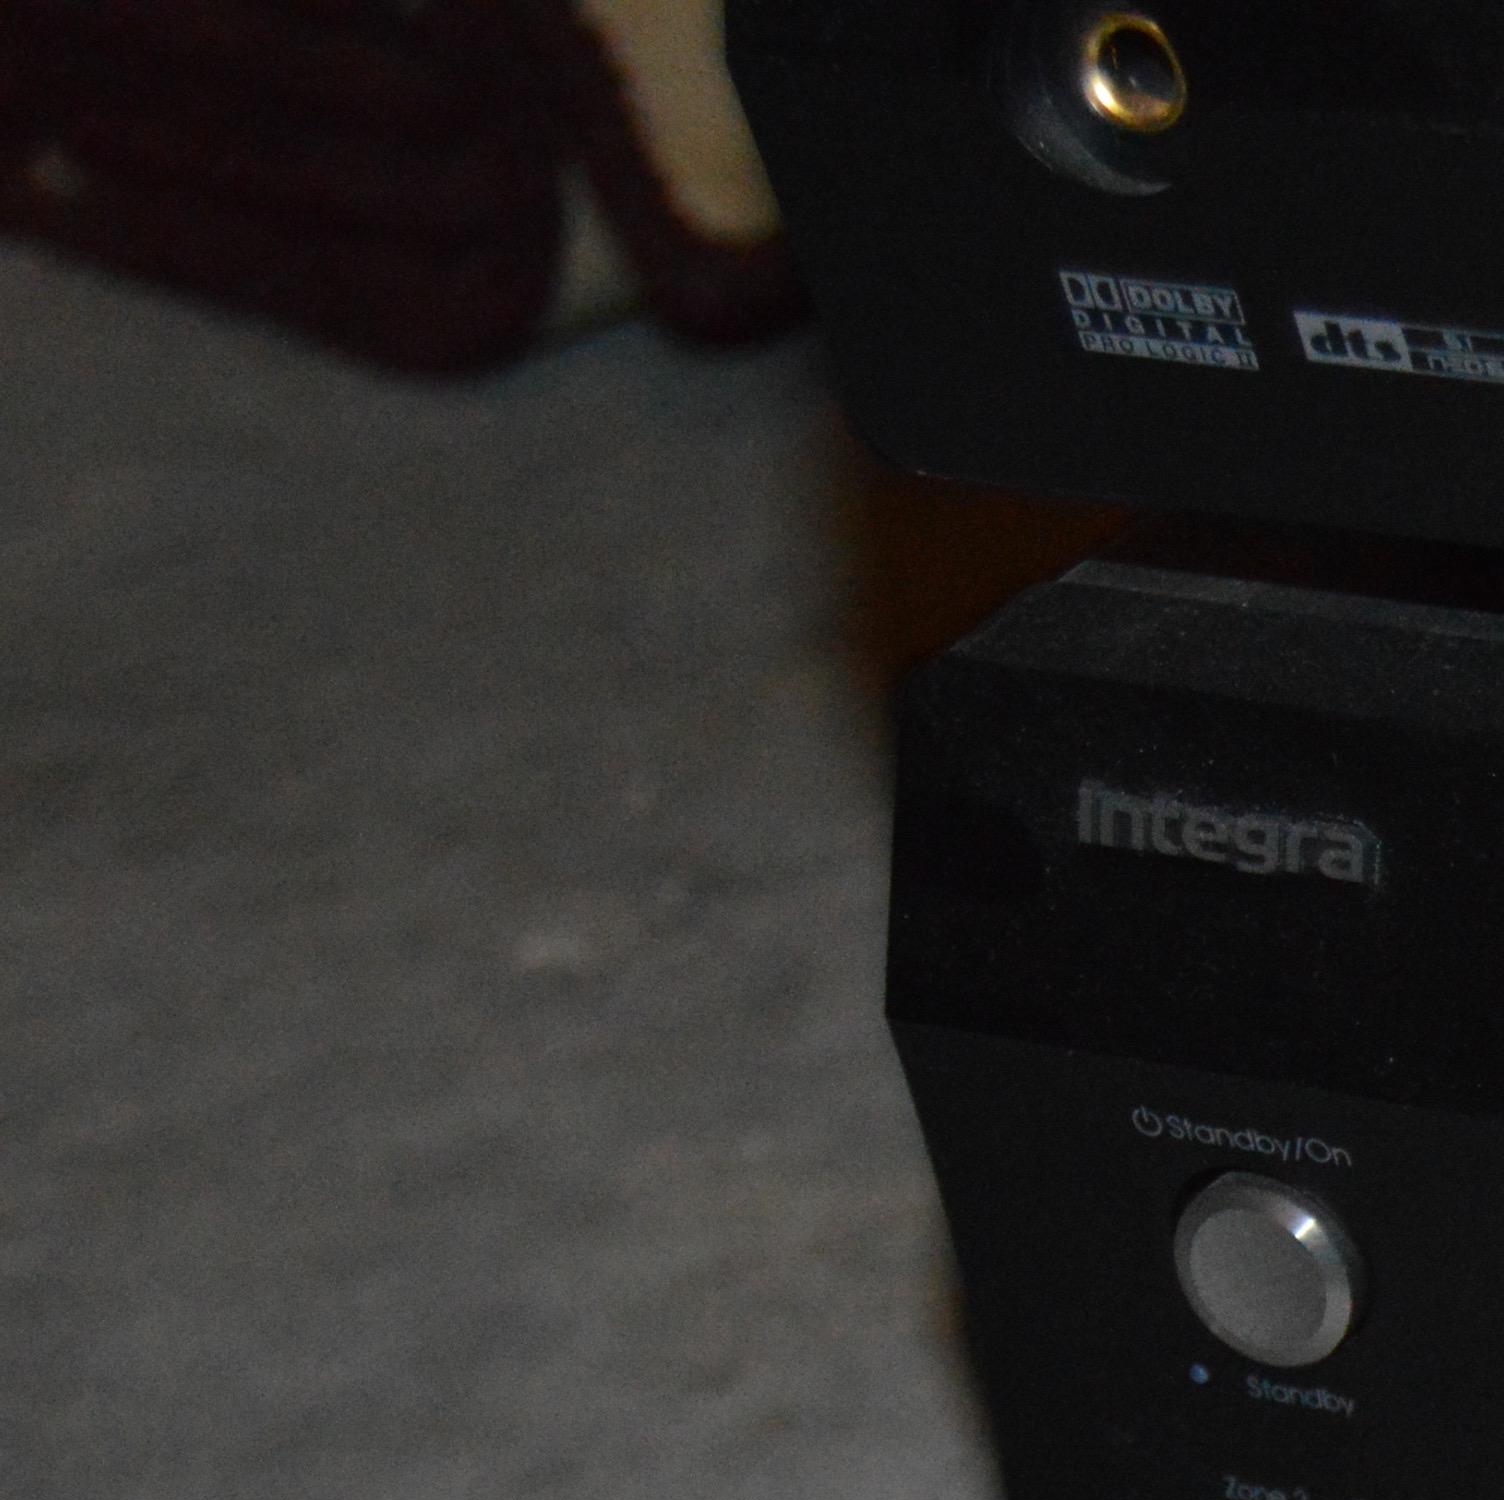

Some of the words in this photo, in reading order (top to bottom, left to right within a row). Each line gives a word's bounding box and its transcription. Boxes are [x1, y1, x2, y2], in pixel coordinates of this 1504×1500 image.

[1126, 283, 1239, 320] DOLBY
[1070, 308, 1254, 347] DIGITAL
[1166, 1114, 1353, 1167] Standby/On
